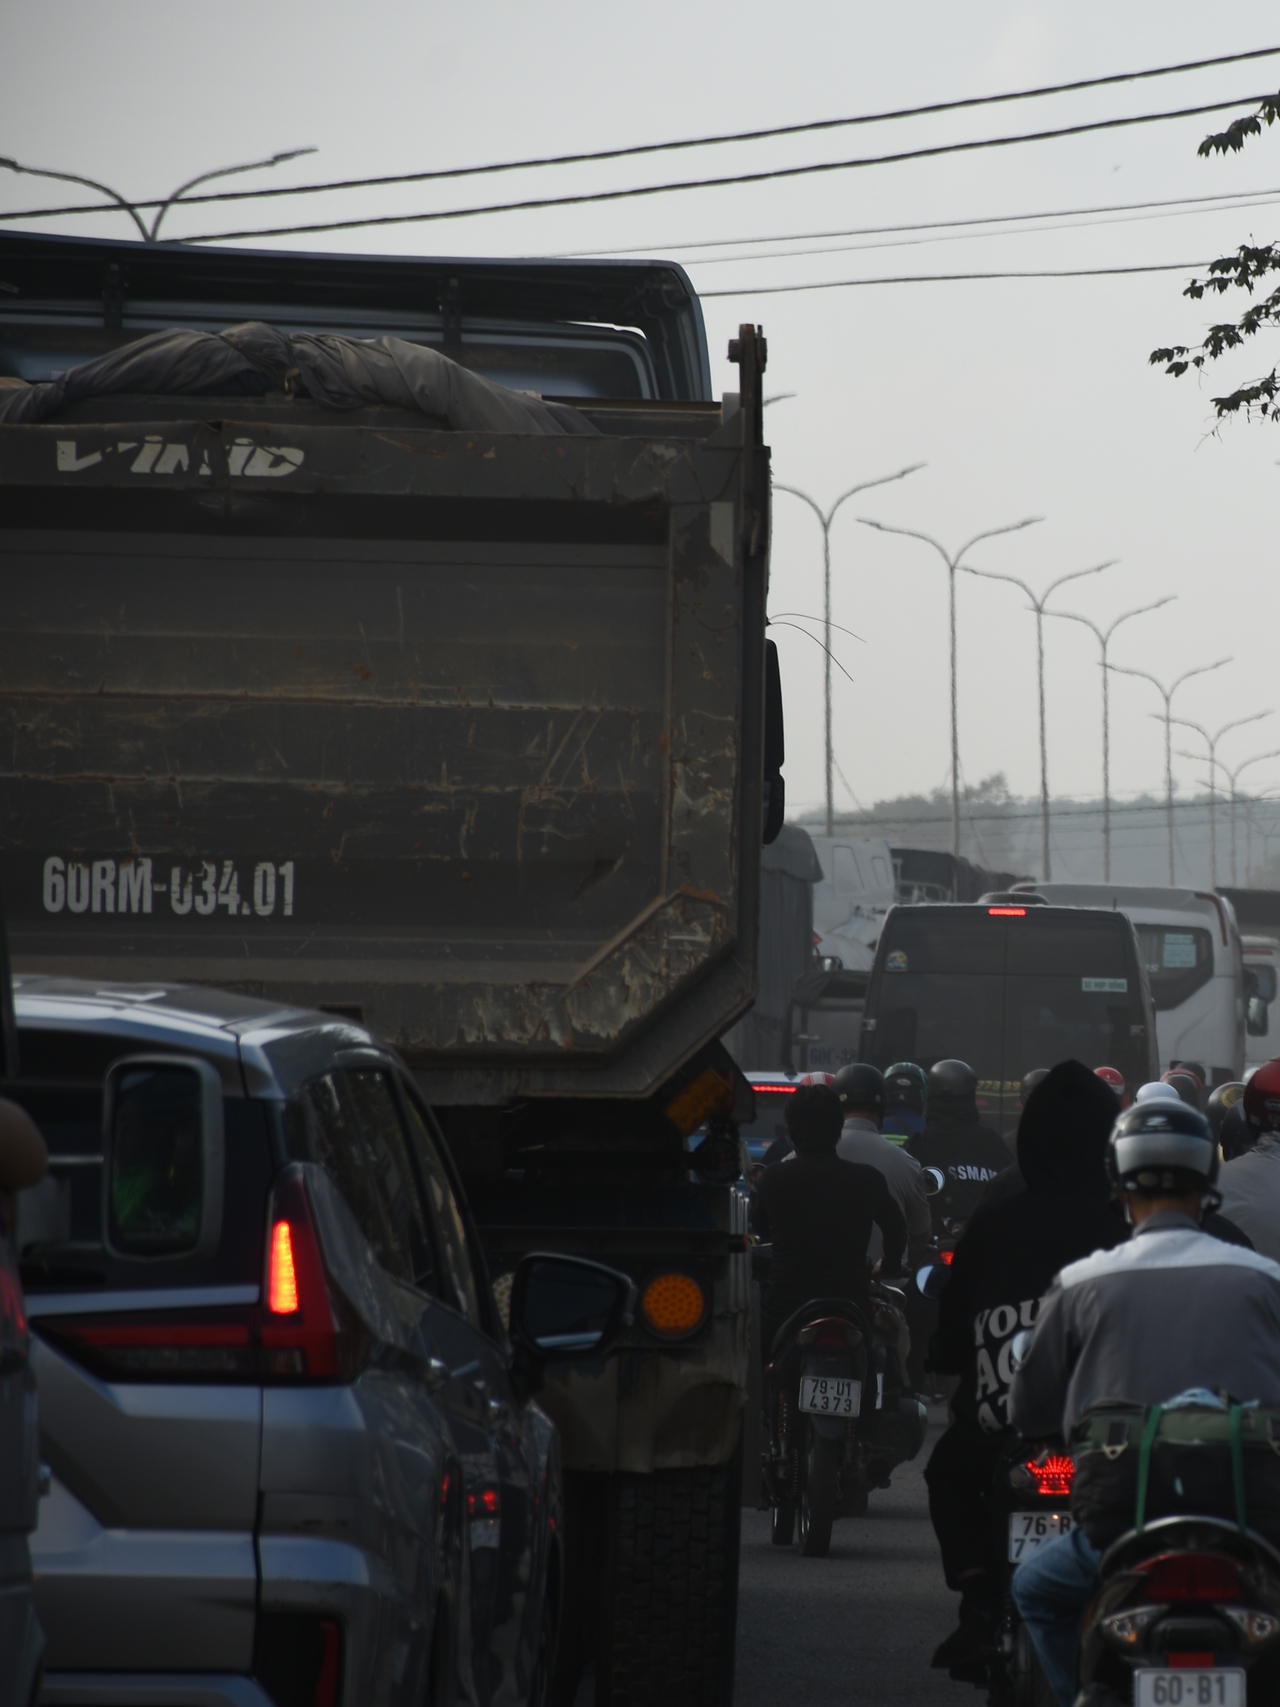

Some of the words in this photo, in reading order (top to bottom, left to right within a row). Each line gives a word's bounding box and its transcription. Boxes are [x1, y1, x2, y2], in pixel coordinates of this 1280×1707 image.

[812, 1379, 852, 1398] 79-U1
[810, 1395, 852, 1413] 4373
[1153, 1675, 1225, 1705] 60-B1
